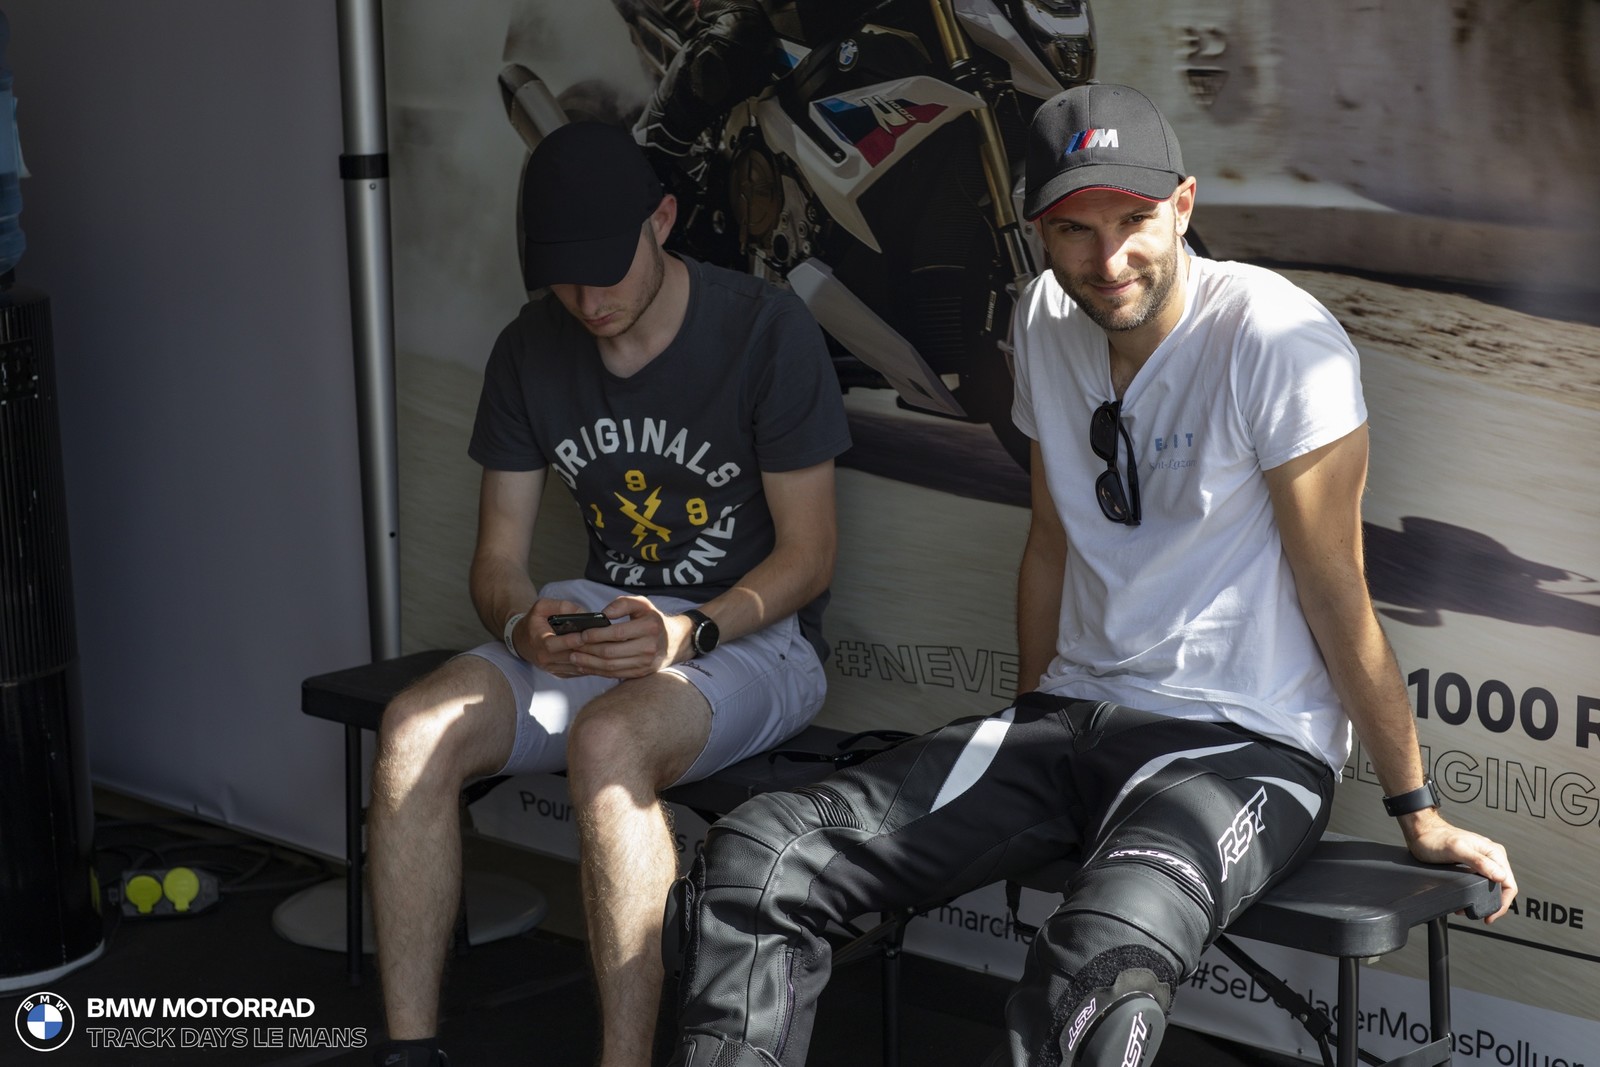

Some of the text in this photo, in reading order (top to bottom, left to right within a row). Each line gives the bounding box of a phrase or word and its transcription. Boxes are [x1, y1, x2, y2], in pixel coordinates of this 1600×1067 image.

[624, 470, 647, 492] 9
[686, 497, 709, 526] 9
[835, 640, 1019, 700] #NEVE
[1408, 667, 1559, 741] 1000
[519, 790, 574, 822] Pour
[1217, 785, 1268, 883] RST
[1526, 897, 1584, 930] RIDE
[1119, 1011, 1148, 1067] ST
